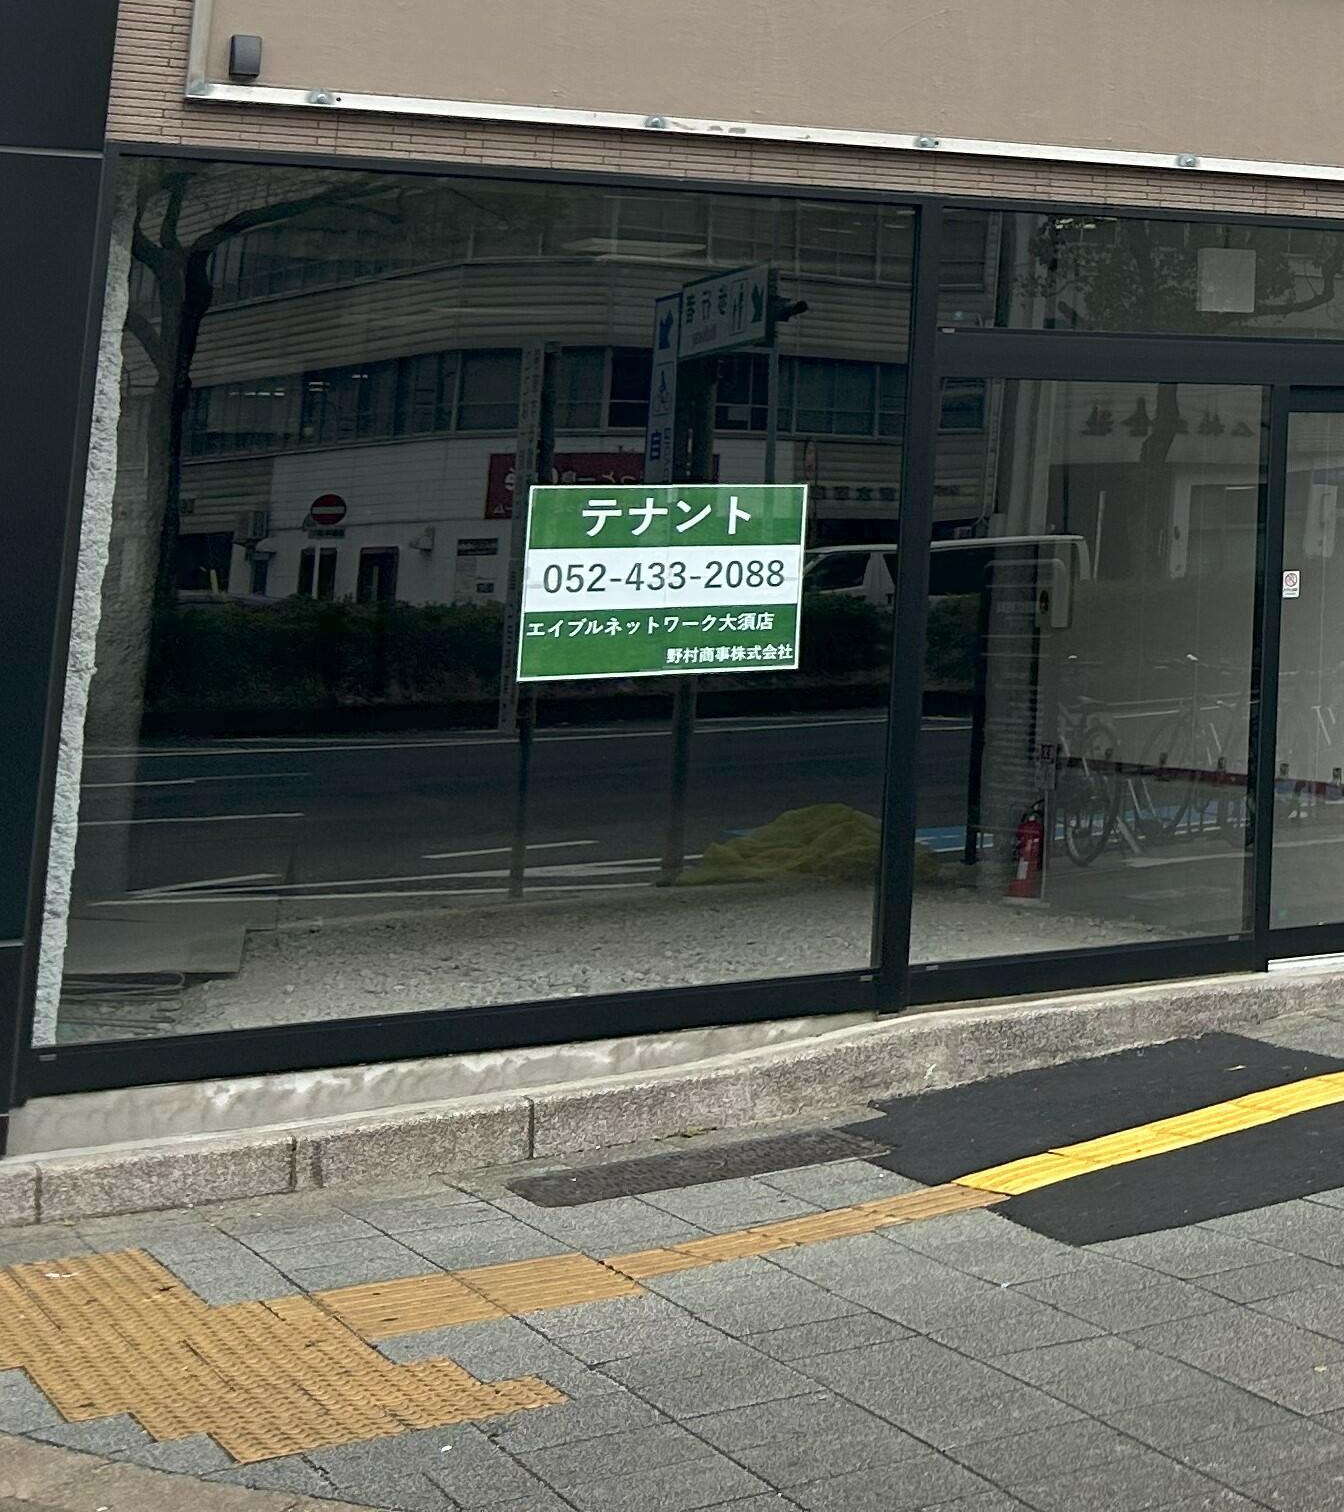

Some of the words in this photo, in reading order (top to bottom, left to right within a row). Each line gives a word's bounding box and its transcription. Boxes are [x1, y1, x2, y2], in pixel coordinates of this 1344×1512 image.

[581, 495, 751, 537] テナント
[543, 559, 785, 594] 052-433-2088
[526, 611, 775, 638] エイブルネットワーク大須店
[666, 643, 793, 664] 野村商事株式会社
